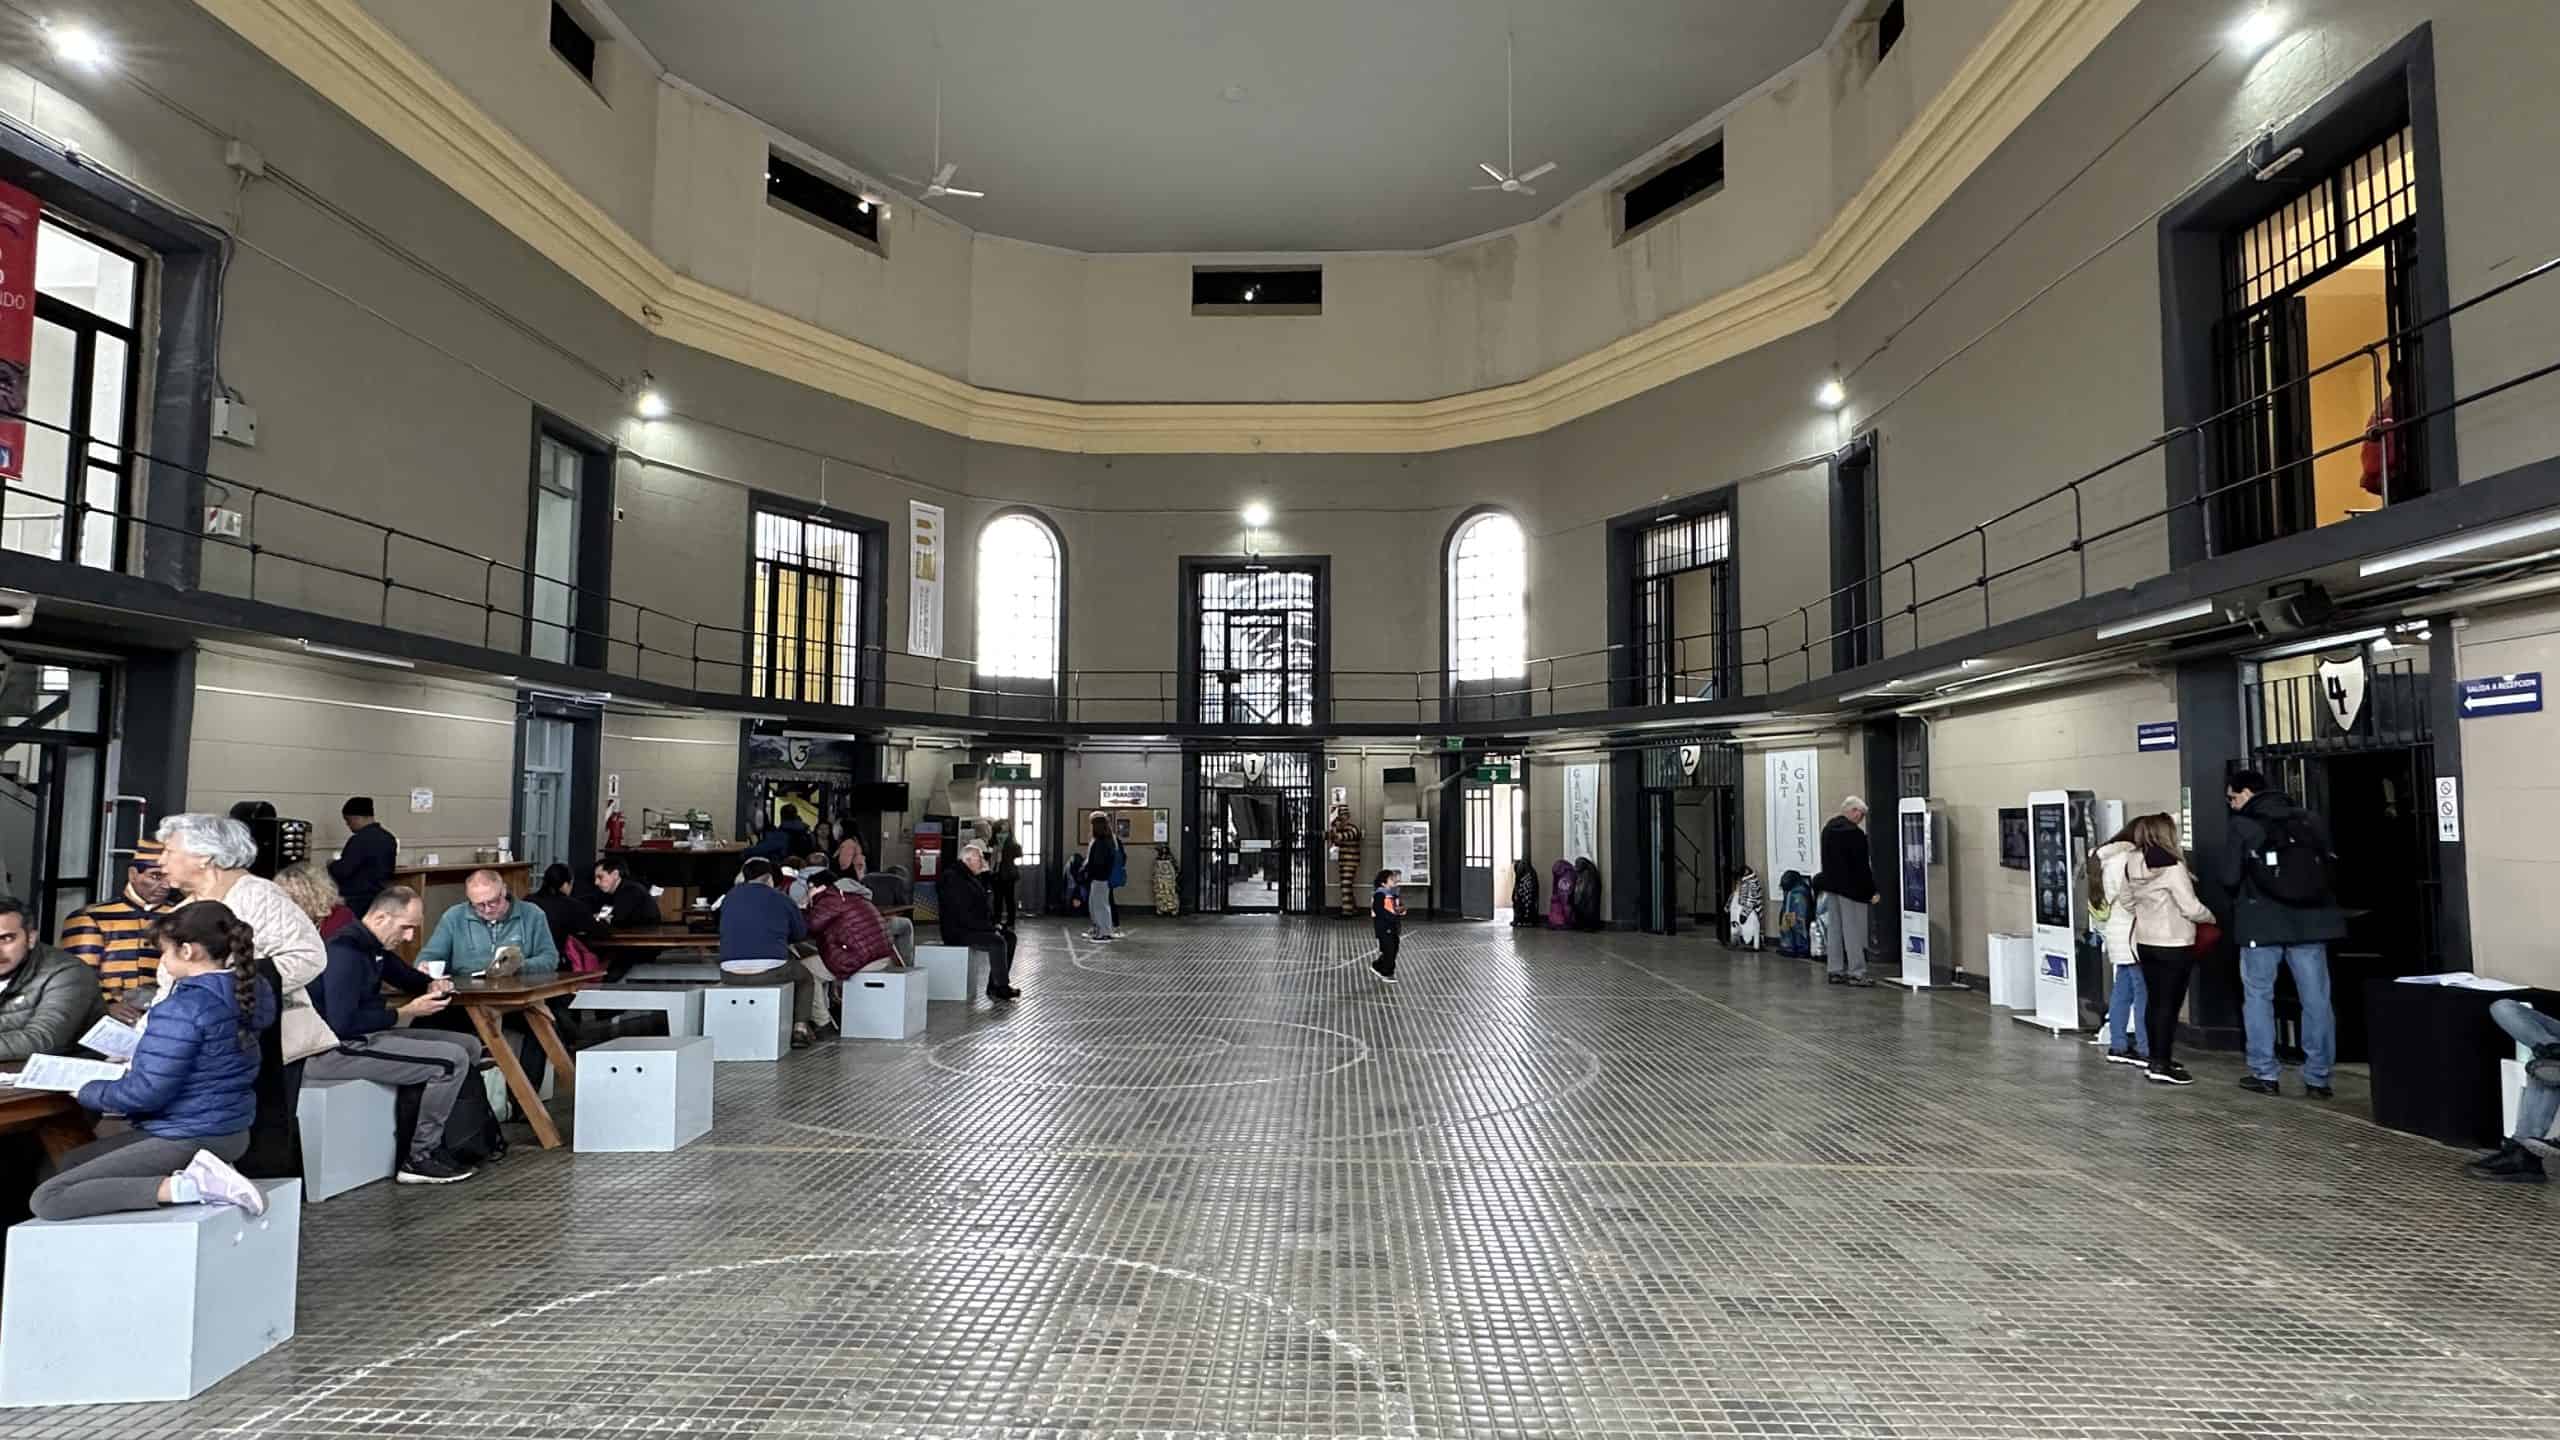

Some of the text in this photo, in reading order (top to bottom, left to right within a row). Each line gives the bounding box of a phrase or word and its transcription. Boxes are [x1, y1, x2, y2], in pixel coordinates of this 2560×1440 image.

[2328, 676, 2348, 715] 4
[794, 745, 809, 762] 3
[1249, 759, 1257, 775] 1
[1682, 748, 1695, 767] 2
[1779, 760, 1789, 798] ART
[1794, 768, 1807, 862] GALLERY
